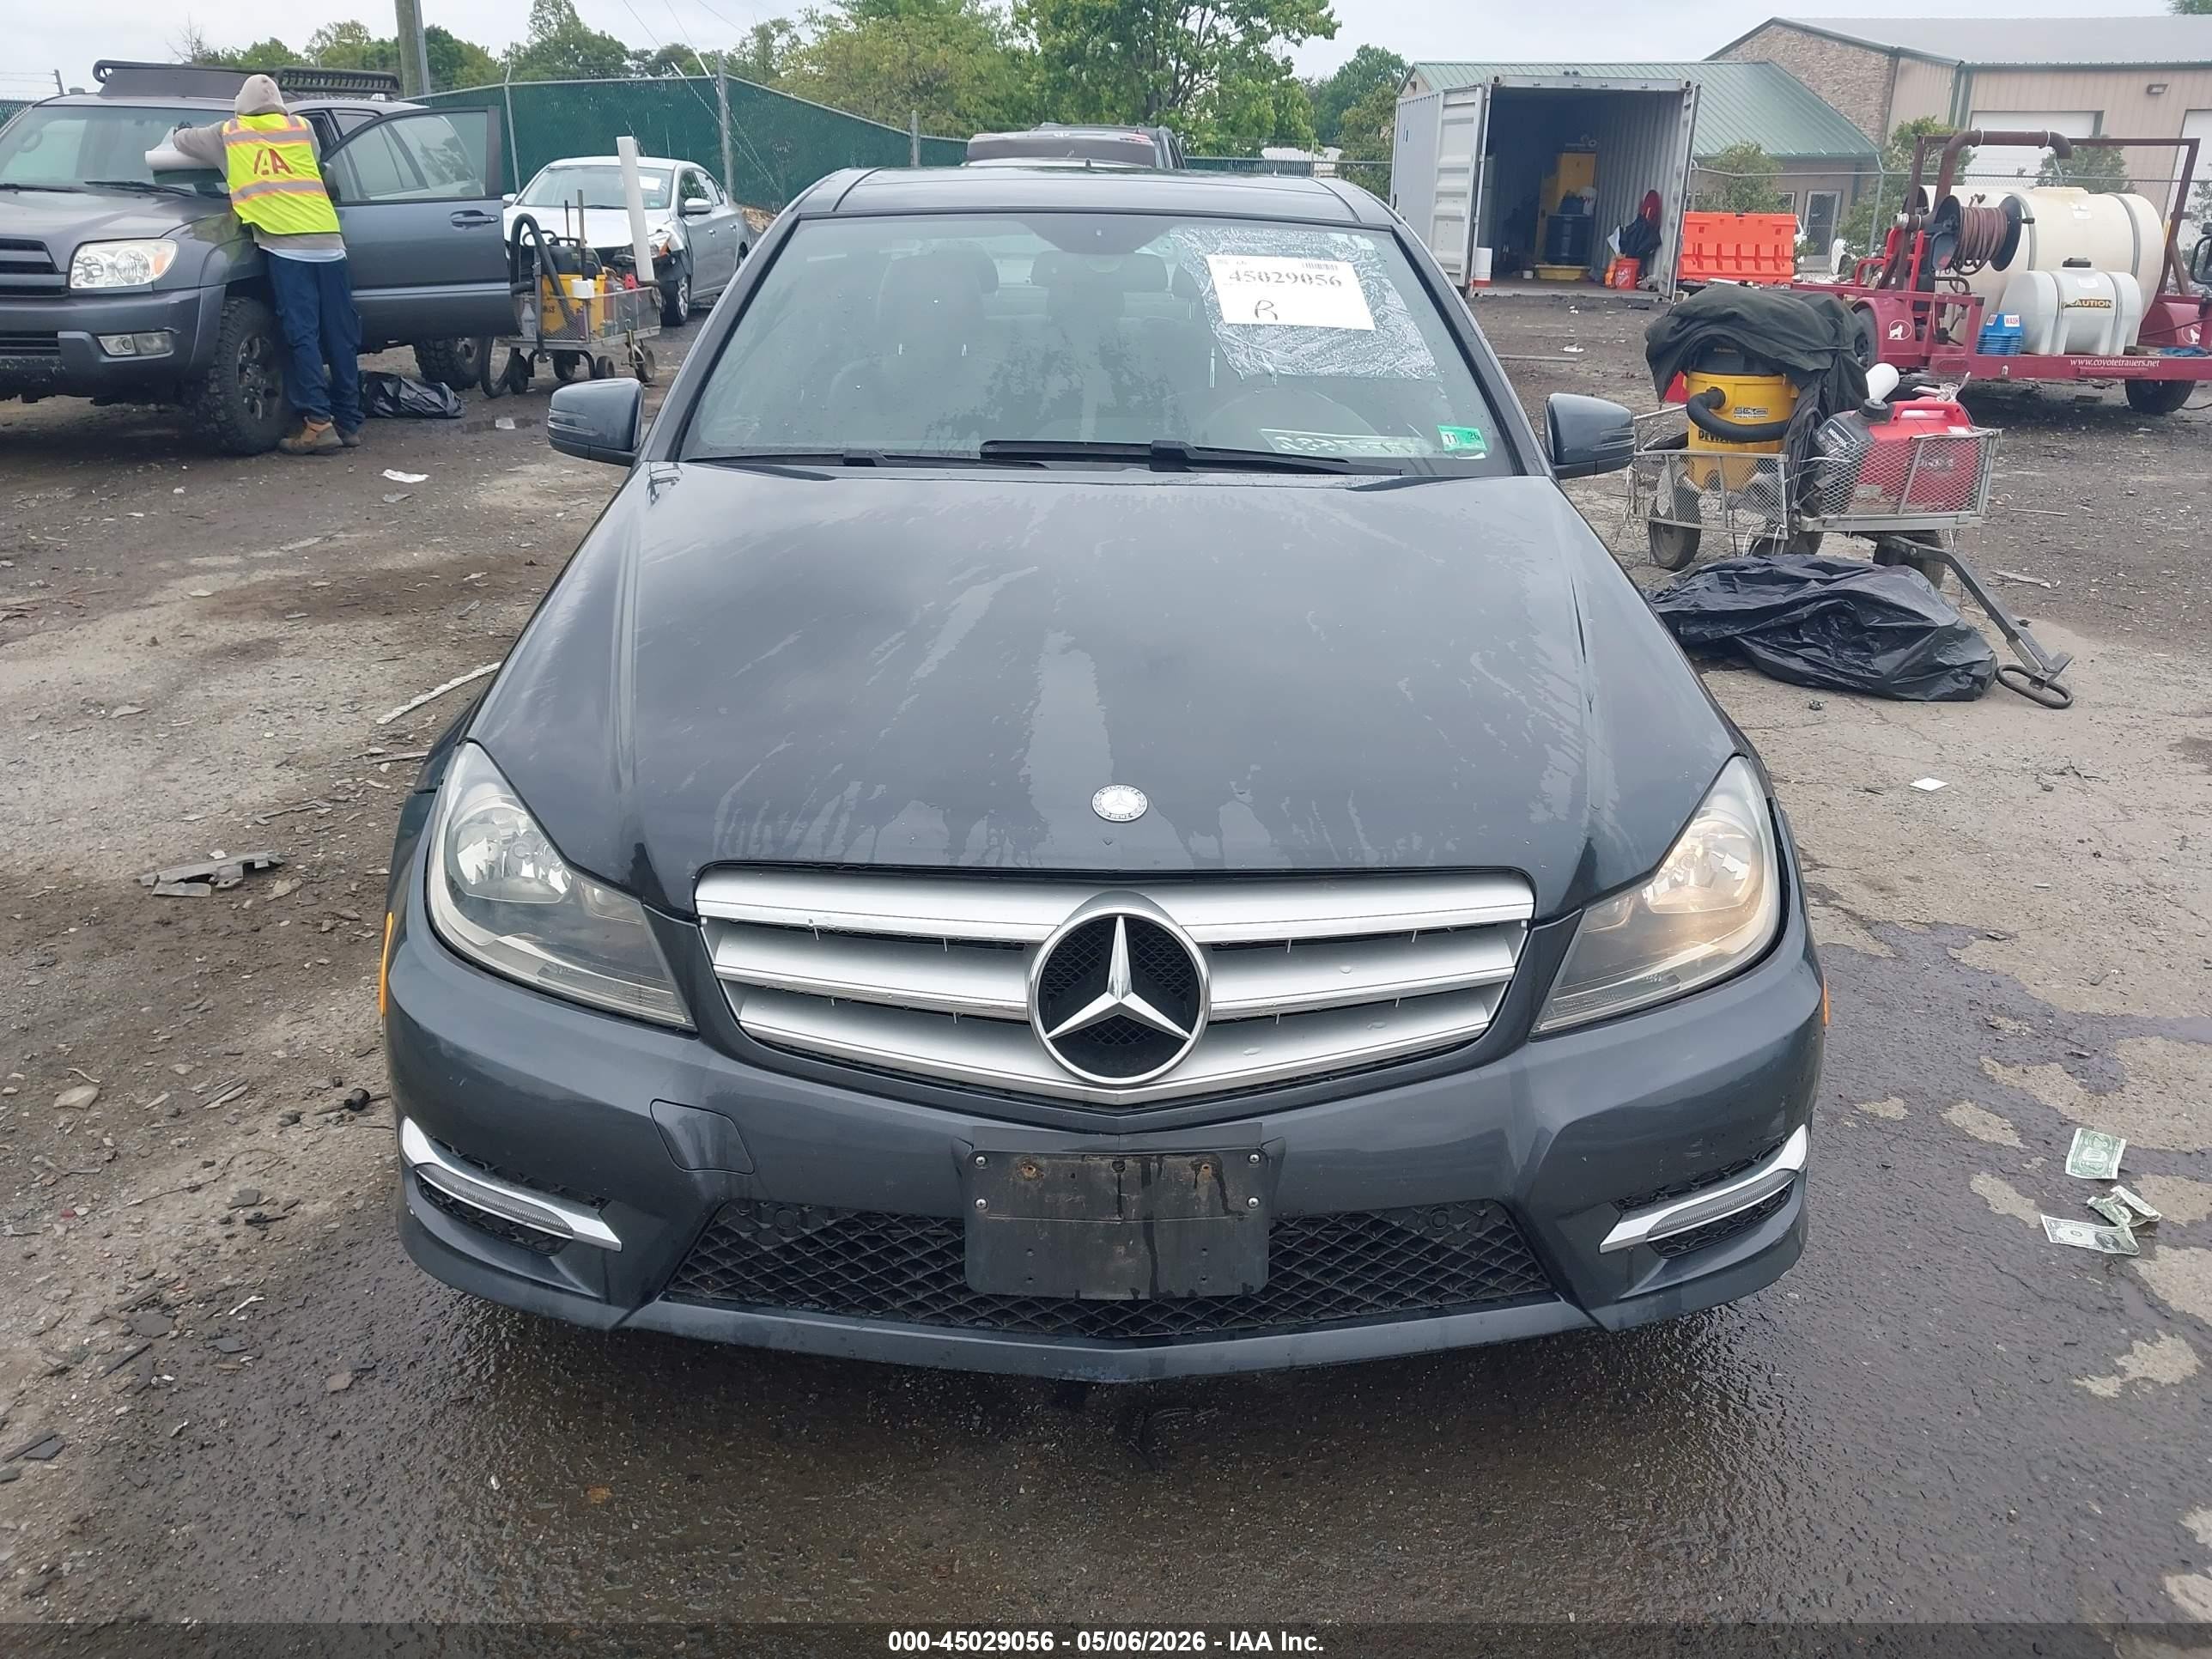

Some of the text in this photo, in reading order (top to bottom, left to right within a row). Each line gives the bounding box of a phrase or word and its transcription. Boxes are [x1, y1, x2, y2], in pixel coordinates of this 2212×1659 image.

[1229, 270, 1342, 287] 45029056
[1255, 300, 1278, 320] R
[2070, 359, 2160, 368] www.coyotetrailers.net
[1468, 431, 1480, 441] 26
